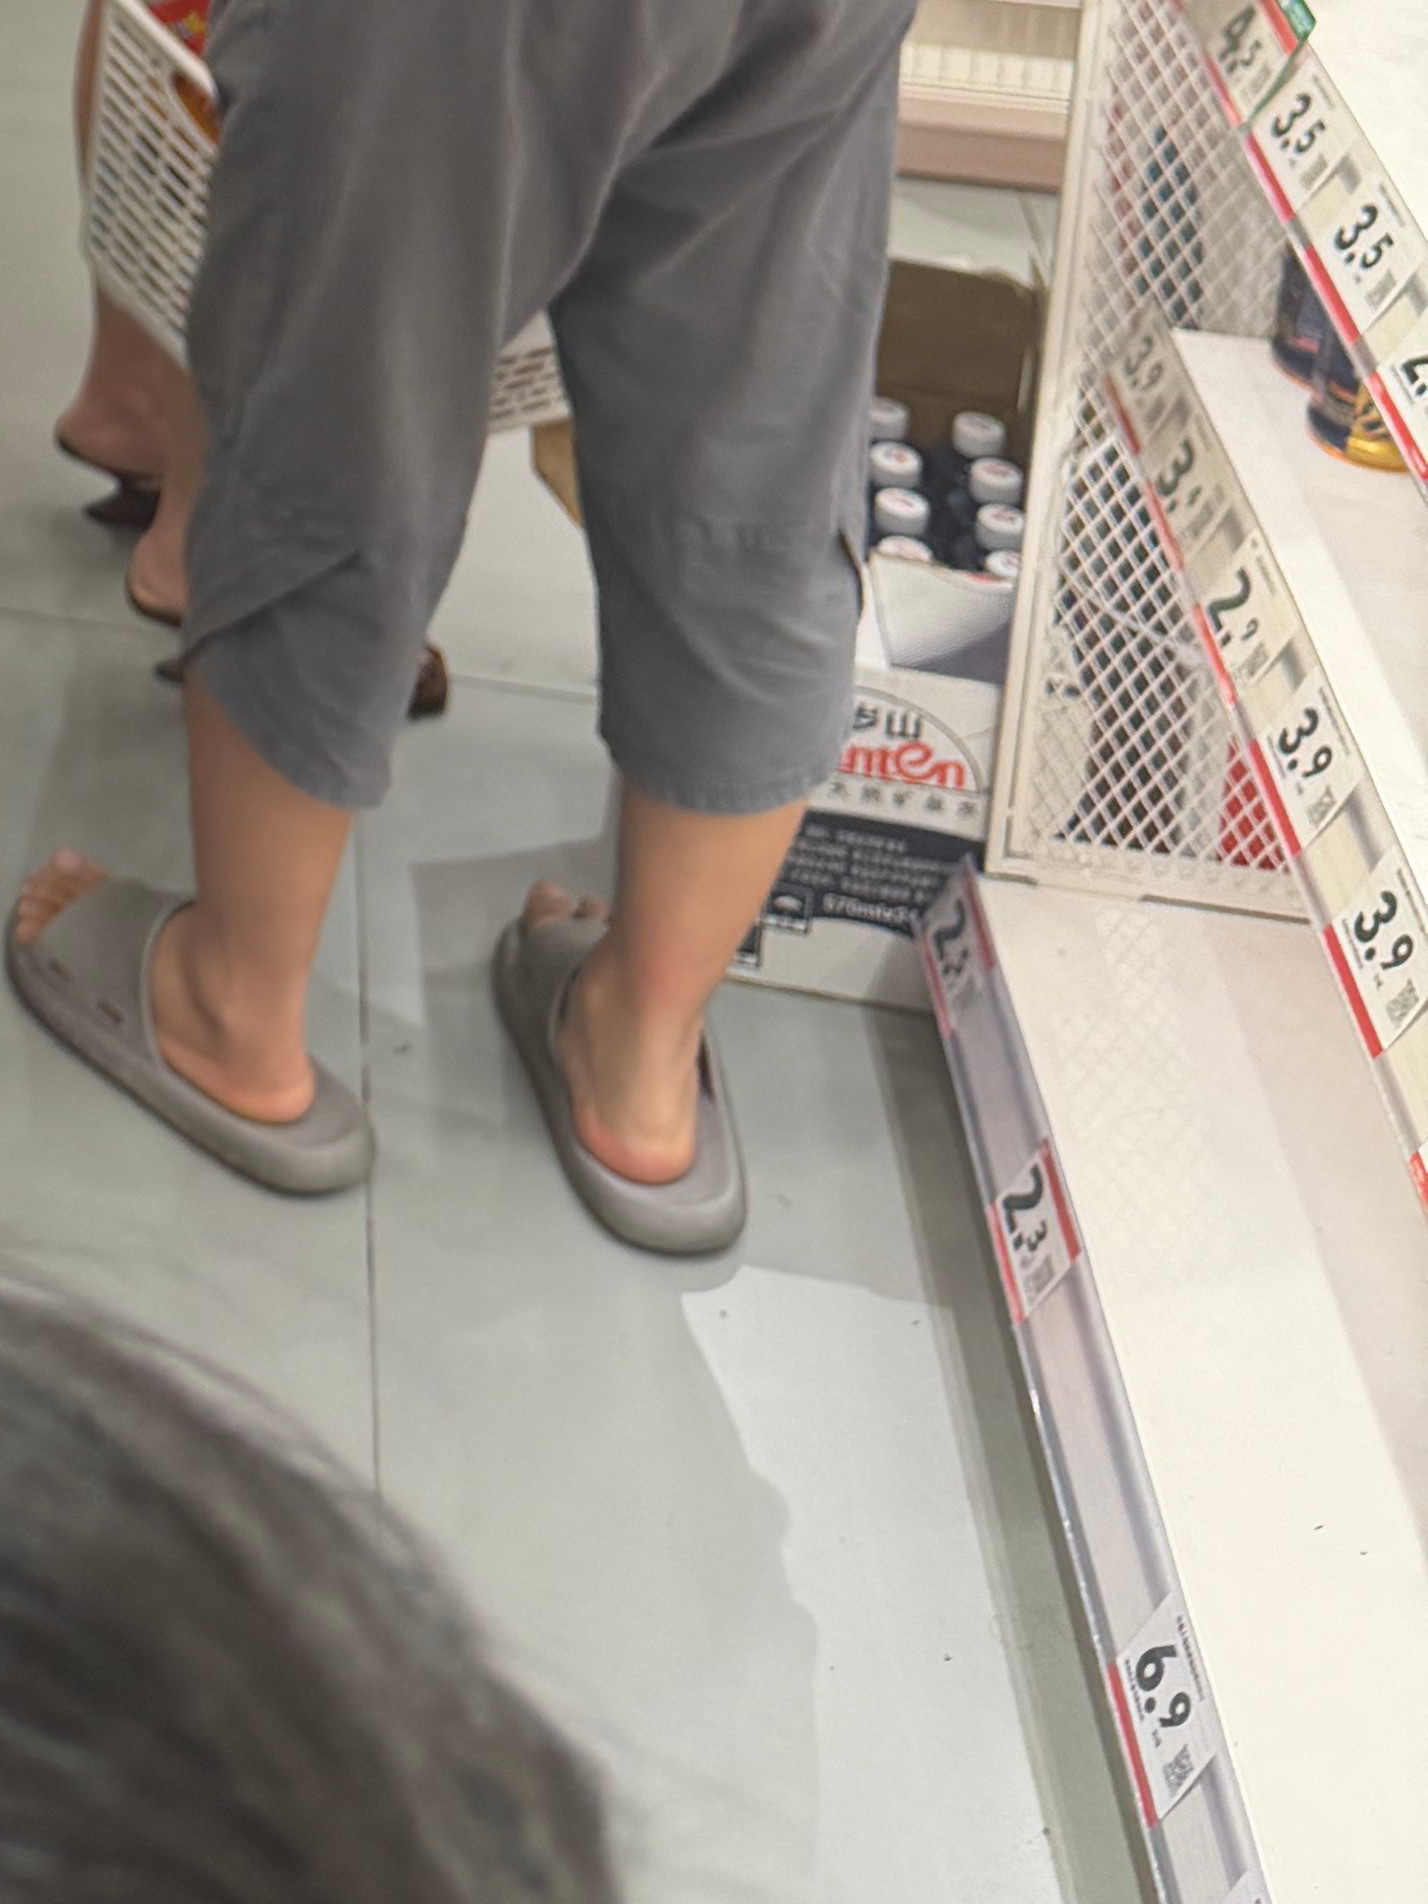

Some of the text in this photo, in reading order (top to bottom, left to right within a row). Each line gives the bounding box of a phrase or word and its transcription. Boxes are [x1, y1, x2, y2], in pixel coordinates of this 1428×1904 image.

[1270, 93, 1326, 156] 3.5
[1334, 204, 1394, 270] 3.5
[1207, 566, 1260, 648] 2.9
[1278, 707, 1333, 779] 3.9
[1354, 890, 1415, 970] 3.9
[1135, 1644, 1192, 1728] 6.9
